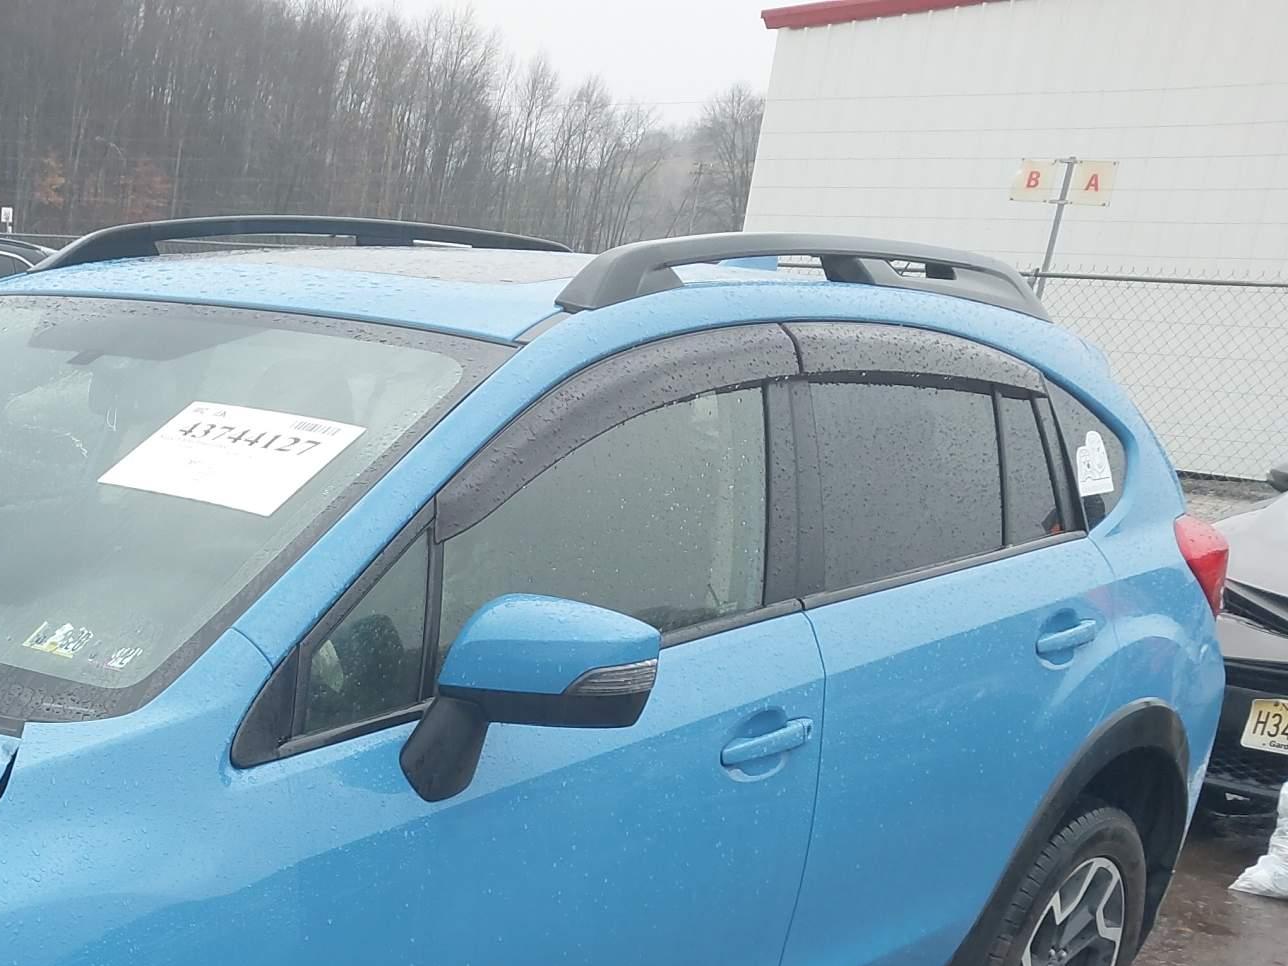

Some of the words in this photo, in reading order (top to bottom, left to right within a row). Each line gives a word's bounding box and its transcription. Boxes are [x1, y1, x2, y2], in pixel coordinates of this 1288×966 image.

[1025, 170, 1041, 189] B
[1084, 174, 1100, 193] A
[178, 421, 322, 457] 43744127
